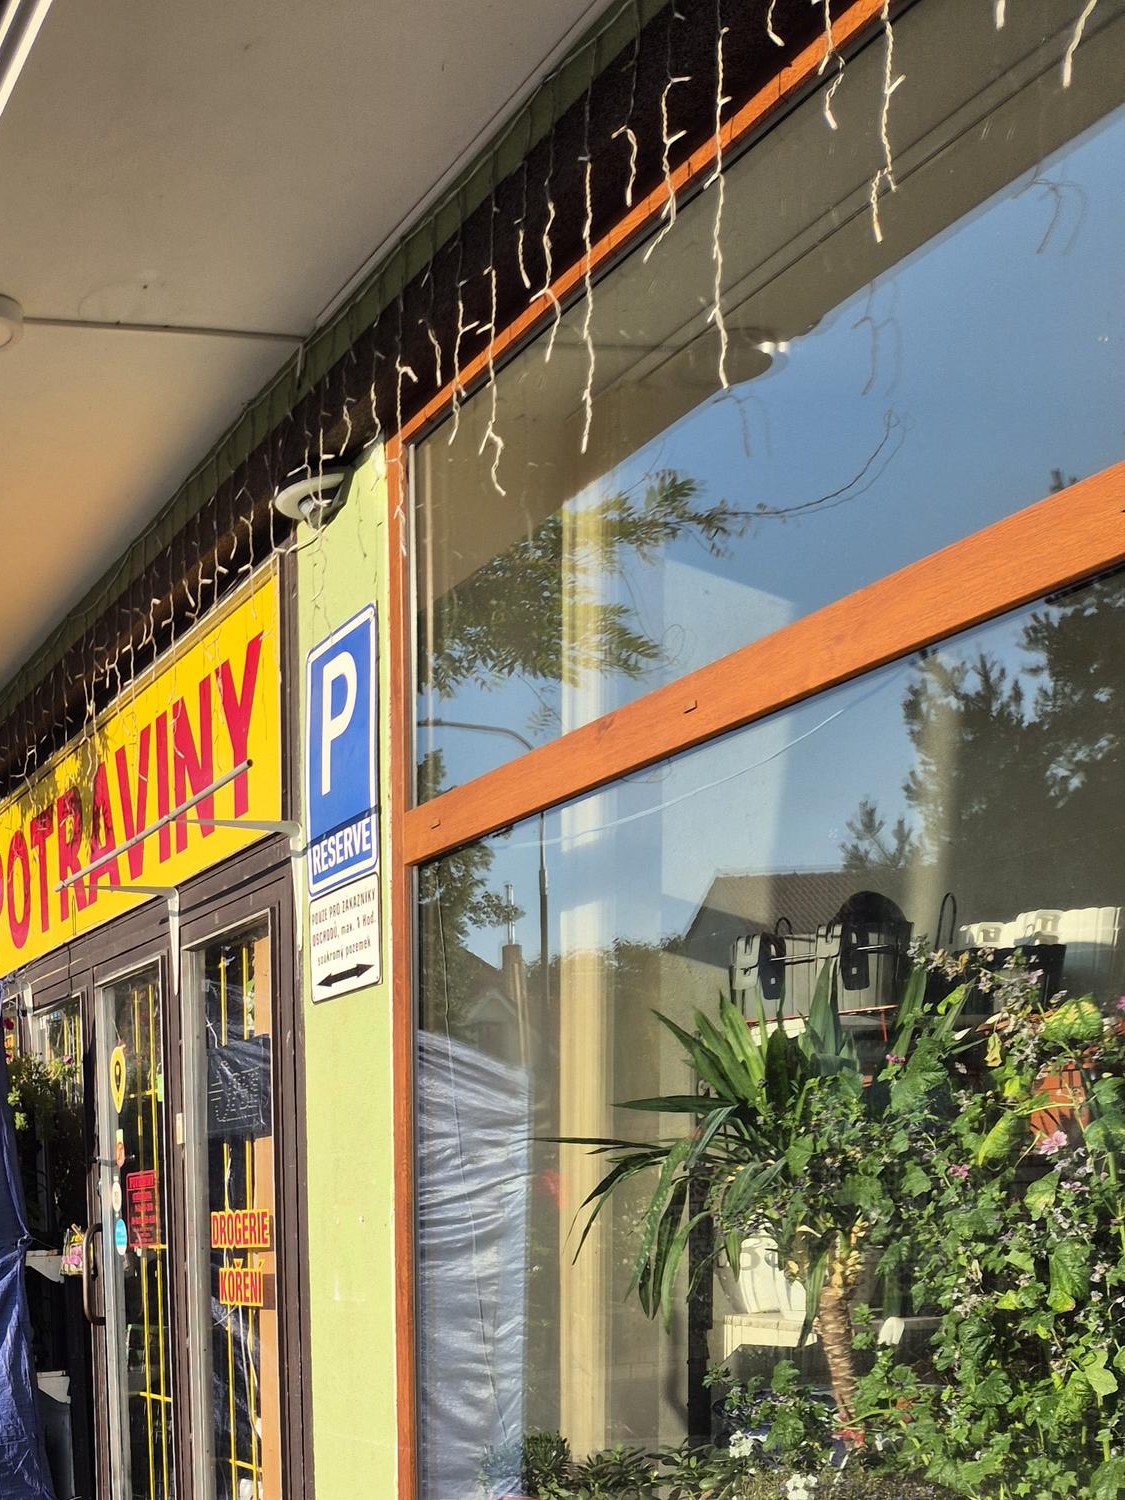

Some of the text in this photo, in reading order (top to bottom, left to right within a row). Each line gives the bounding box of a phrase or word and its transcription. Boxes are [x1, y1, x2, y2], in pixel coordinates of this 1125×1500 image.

[321, 651, 357, 796] P
[312, 811, 371, 876] RÉSERVÉ
[312, 888, 376, 926] POUZE PRO ZÁKAZNÍKY
[317, 936, 371, 966] soukromý pozemek
[211, 1210, 269, 1247] DROGERIE
[219, 1260, 263, 1305] KOŘENÍ
